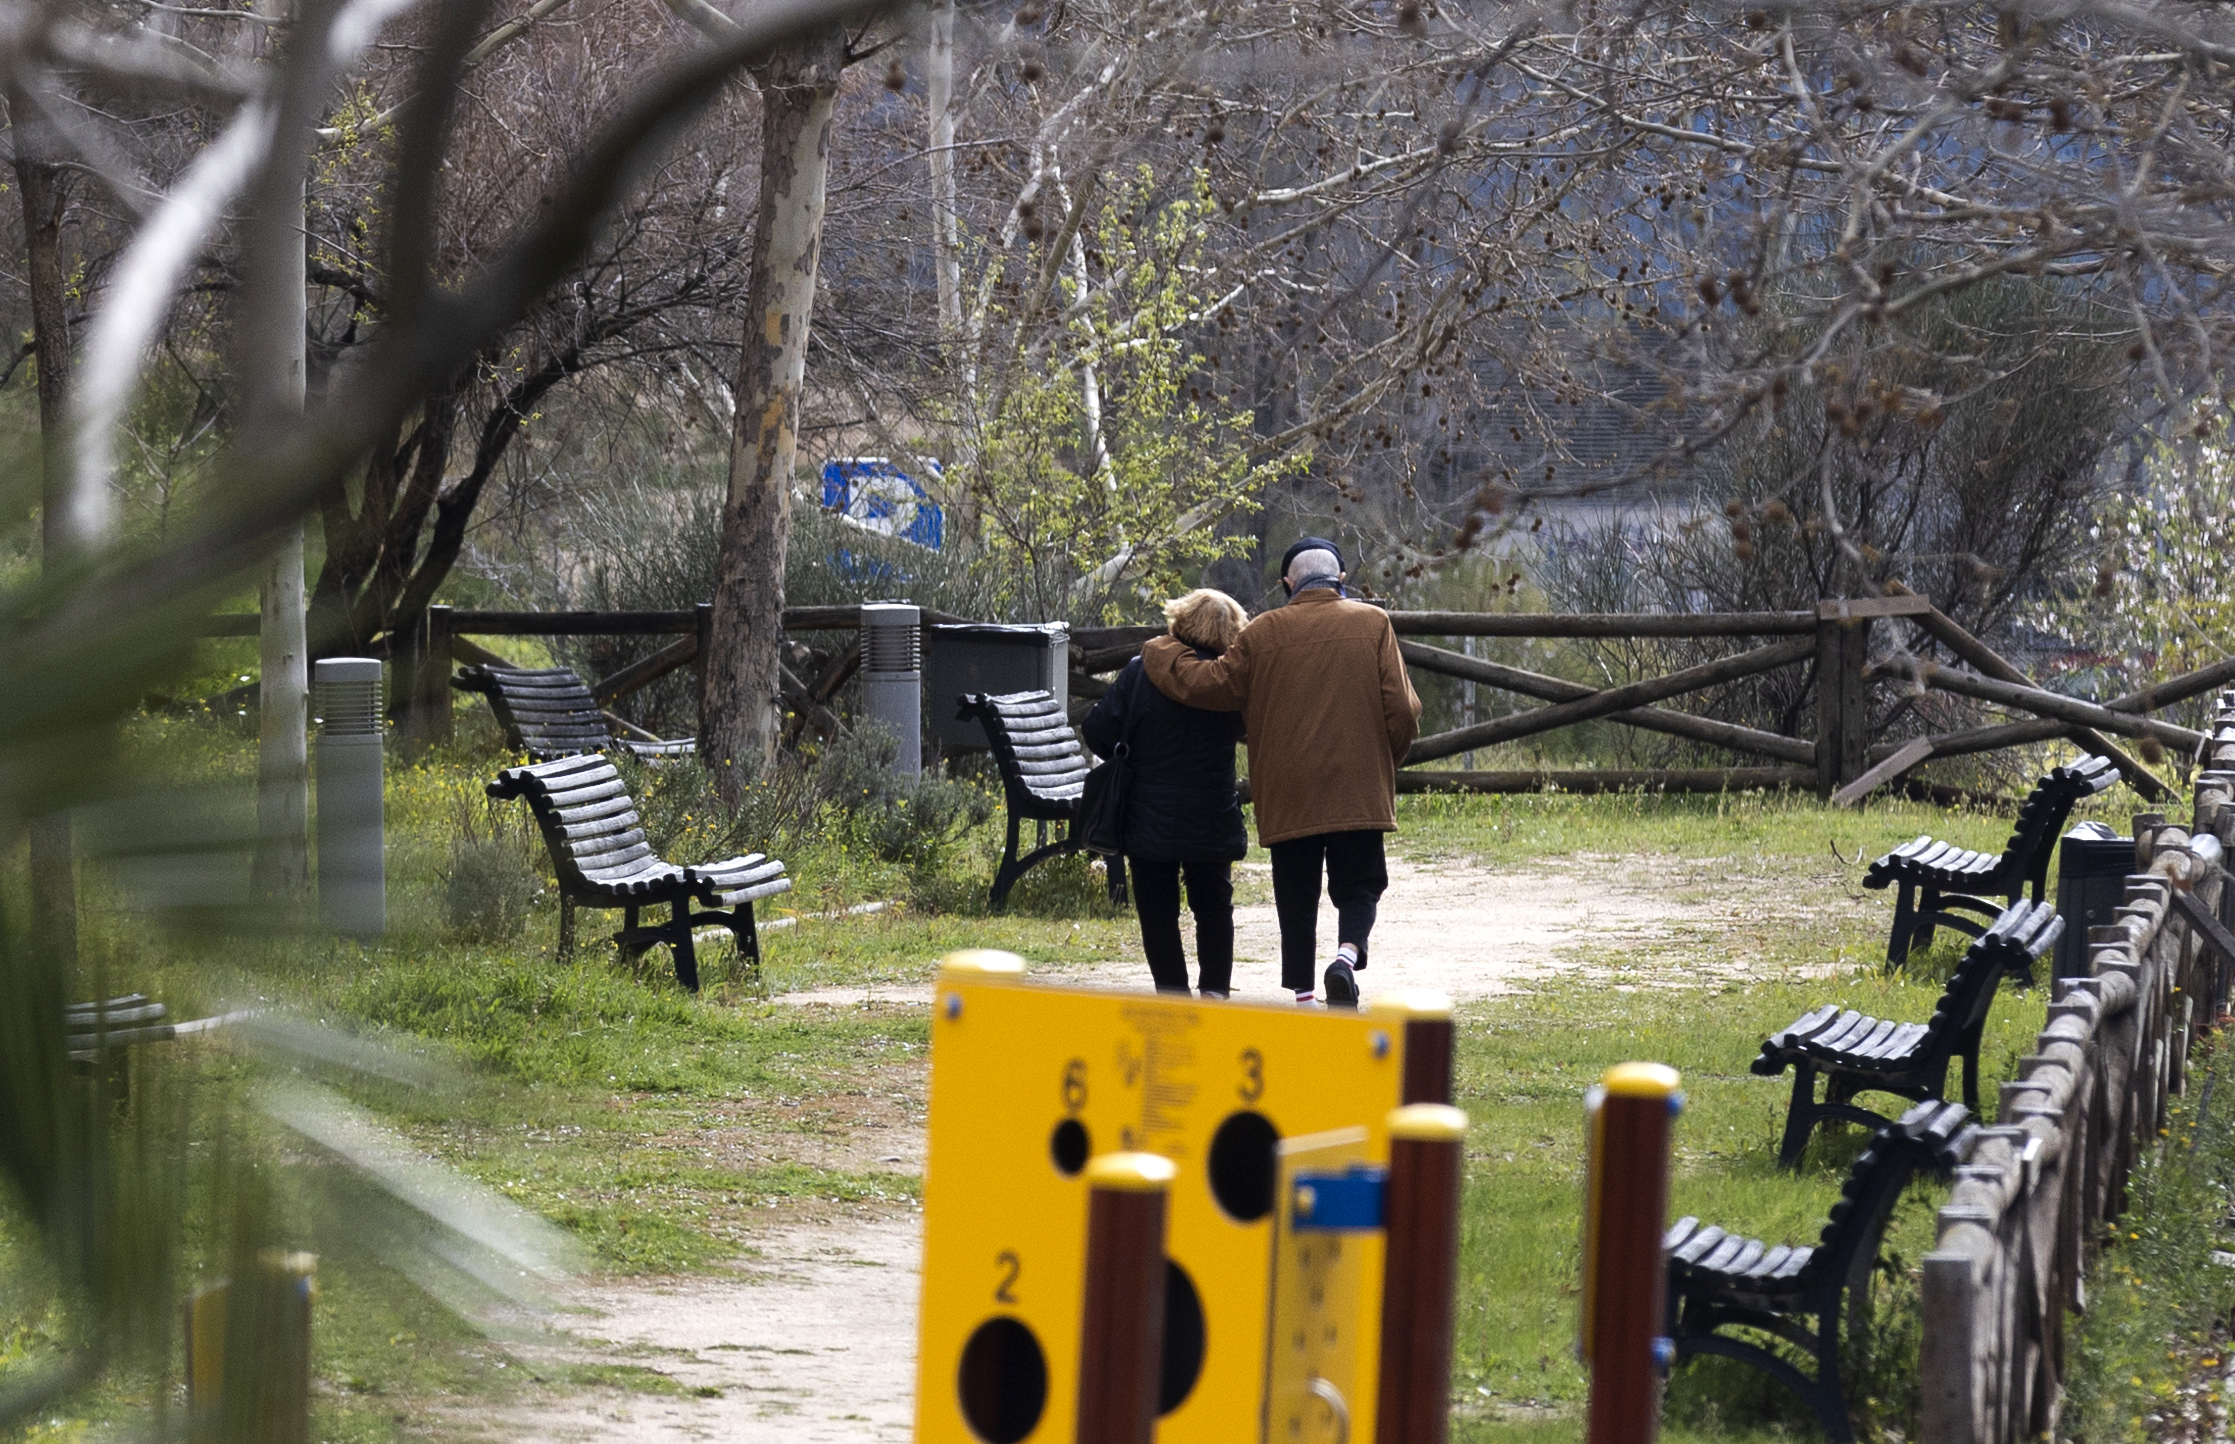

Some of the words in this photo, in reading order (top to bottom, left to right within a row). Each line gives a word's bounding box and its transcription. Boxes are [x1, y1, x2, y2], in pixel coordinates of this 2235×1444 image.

[1061, 1059, 1088, 1112] 6
[1238, 1048, 1264, 1102] 3
[994, 1251, 1020, 1304] 2
